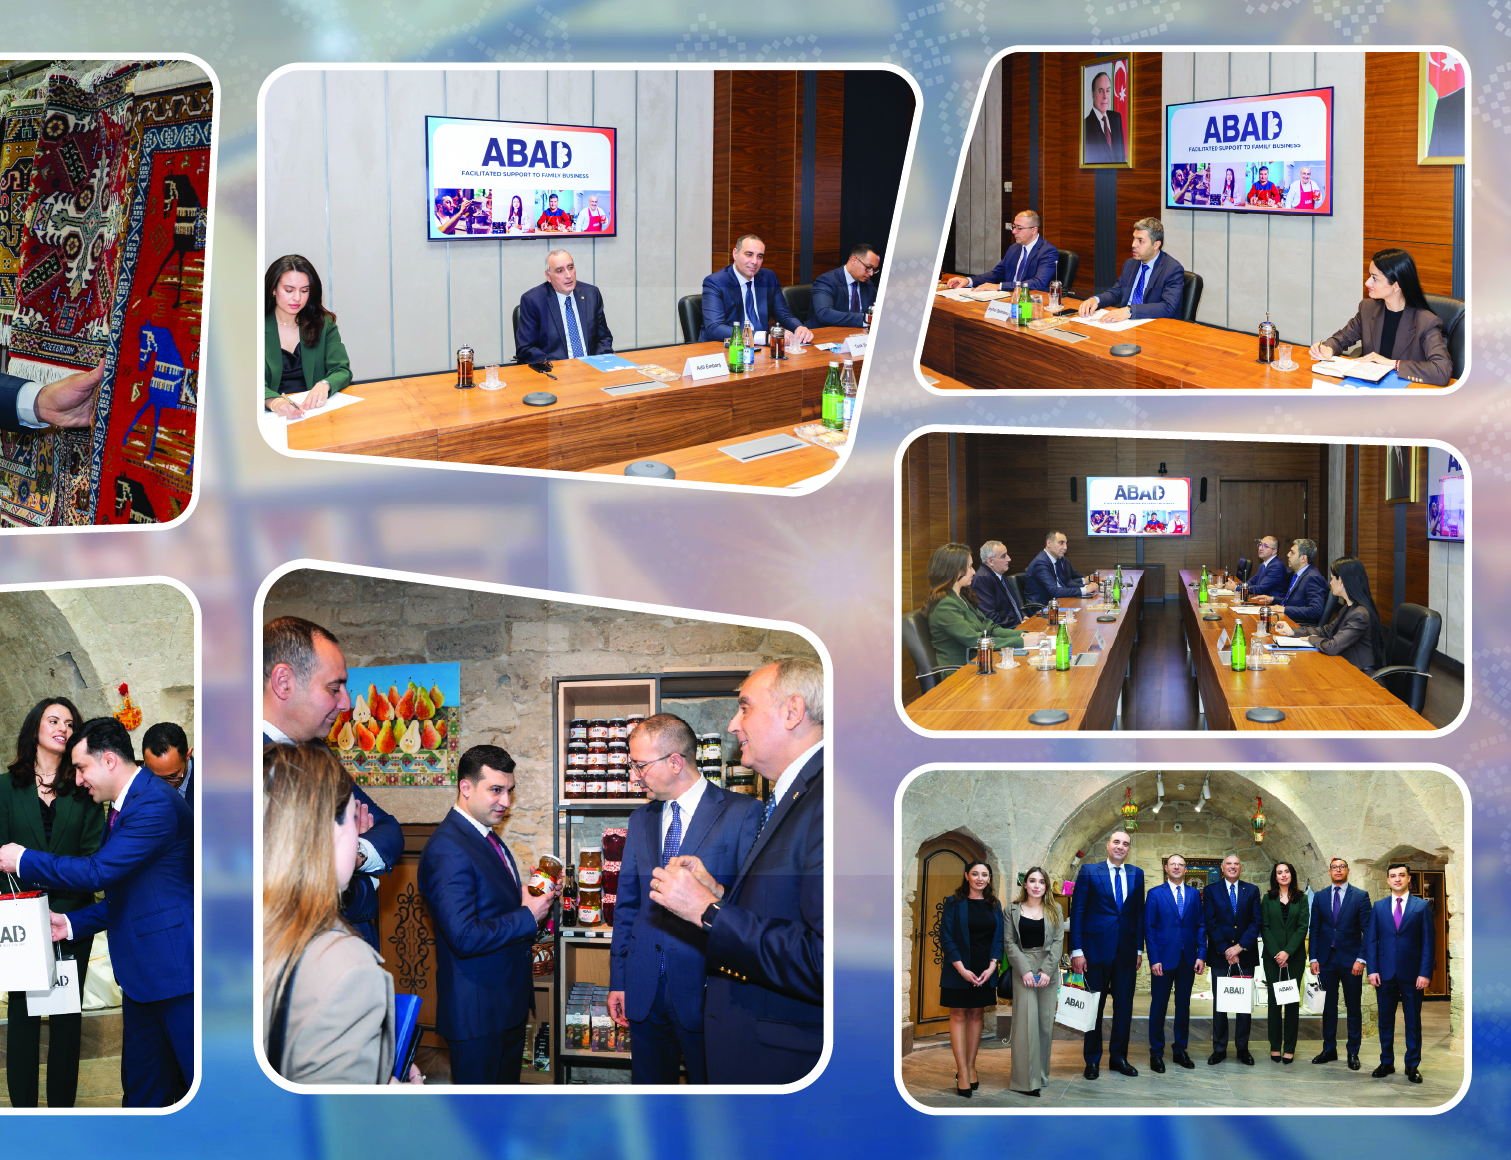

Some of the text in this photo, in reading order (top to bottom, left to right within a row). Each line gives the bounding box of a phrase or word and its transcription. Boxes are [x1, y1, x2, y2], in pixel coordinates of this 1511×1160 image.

[1203, 110, 1283, 144] ABAD
[481, 137, 573, 169] ABAD
[1114, 484, 1166, 501] ABAD
[1223, 986, 1245, 995] ABAD
[1064, 996, 1085, 1010] ABAD
